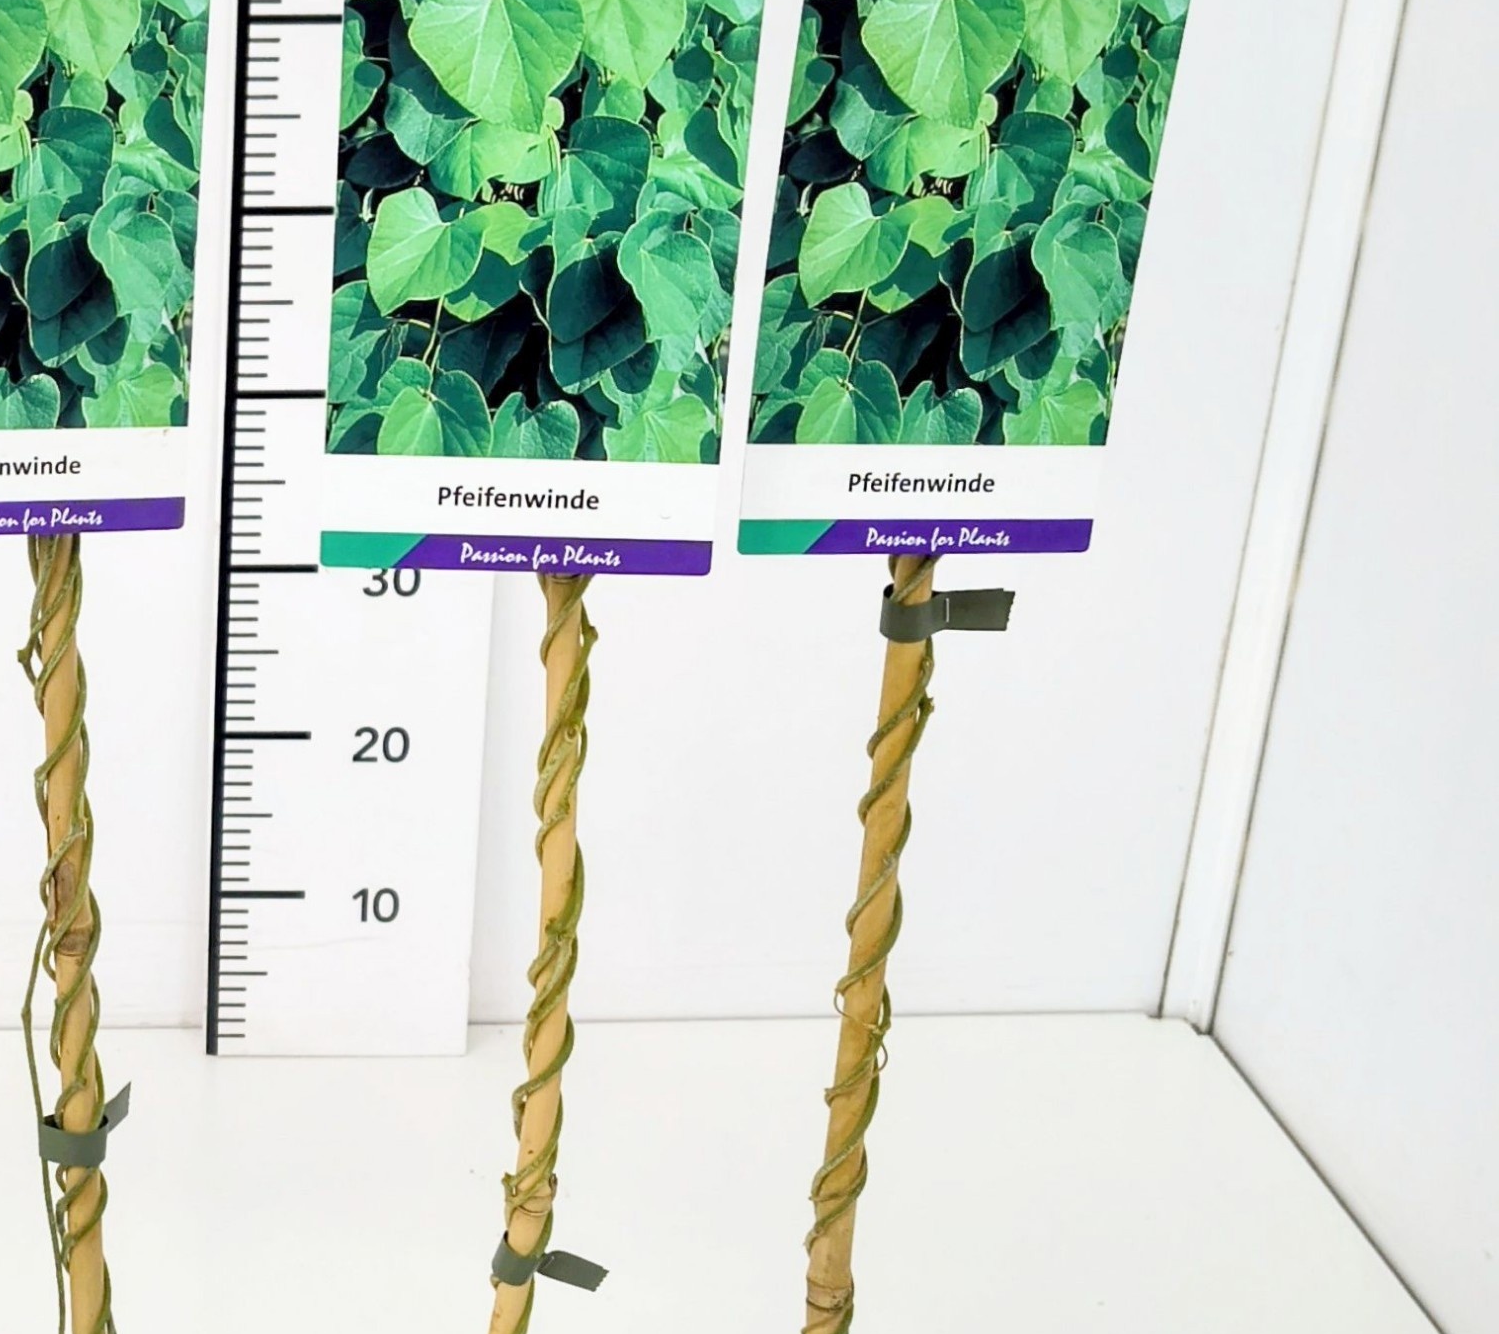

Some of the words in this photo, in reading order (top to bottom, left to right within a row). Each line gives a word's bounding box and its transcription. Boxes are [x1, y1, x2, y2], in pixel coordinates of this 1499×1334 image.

[848, 472, 995, 493] Pfeifenwinde
[438, 485, 600, 510] Pfeifenwinde
[22, 508, 47, 533] for
[50, 507, 103, 528] Plants
[865, 527, 927, 547] Passion
[930, 526, 955, 552] for
[958, 526, 1010, 547] Plants
[460, 541, 528, 564] Passion
[531, 544, 559, 569] for
[562, 544, 621, 567] Plants
[352, 726, 410, 763] 20
[352, 887, 400, 923] 10
